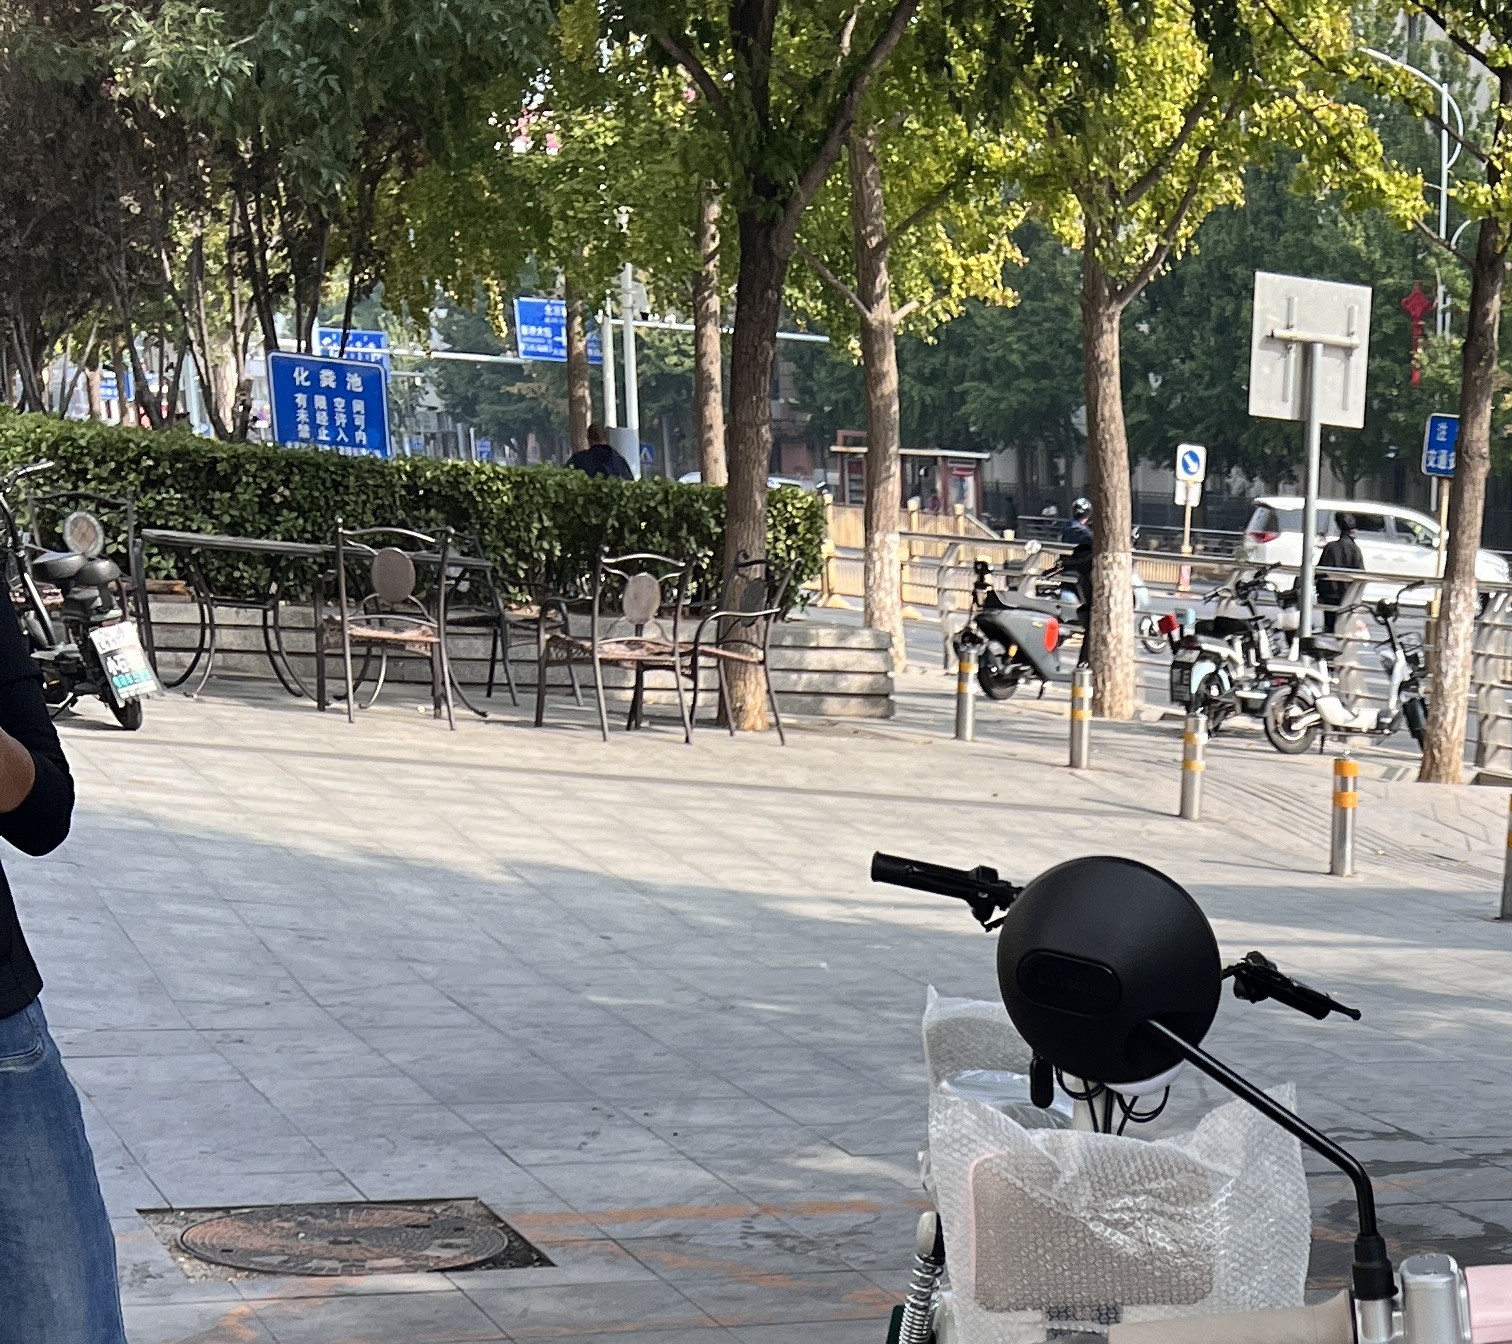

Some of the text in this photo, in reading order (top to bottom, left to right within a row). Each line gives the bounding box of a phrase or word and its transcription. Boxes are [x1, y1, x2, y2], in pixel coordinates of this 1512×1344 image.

[293, 366, 364, 393] 化粪池
[294, 393, 366, 415] 有限空间
[296, 409, 366, 430] 未经许可
[297, 423, 367, 445] 禁止入内
